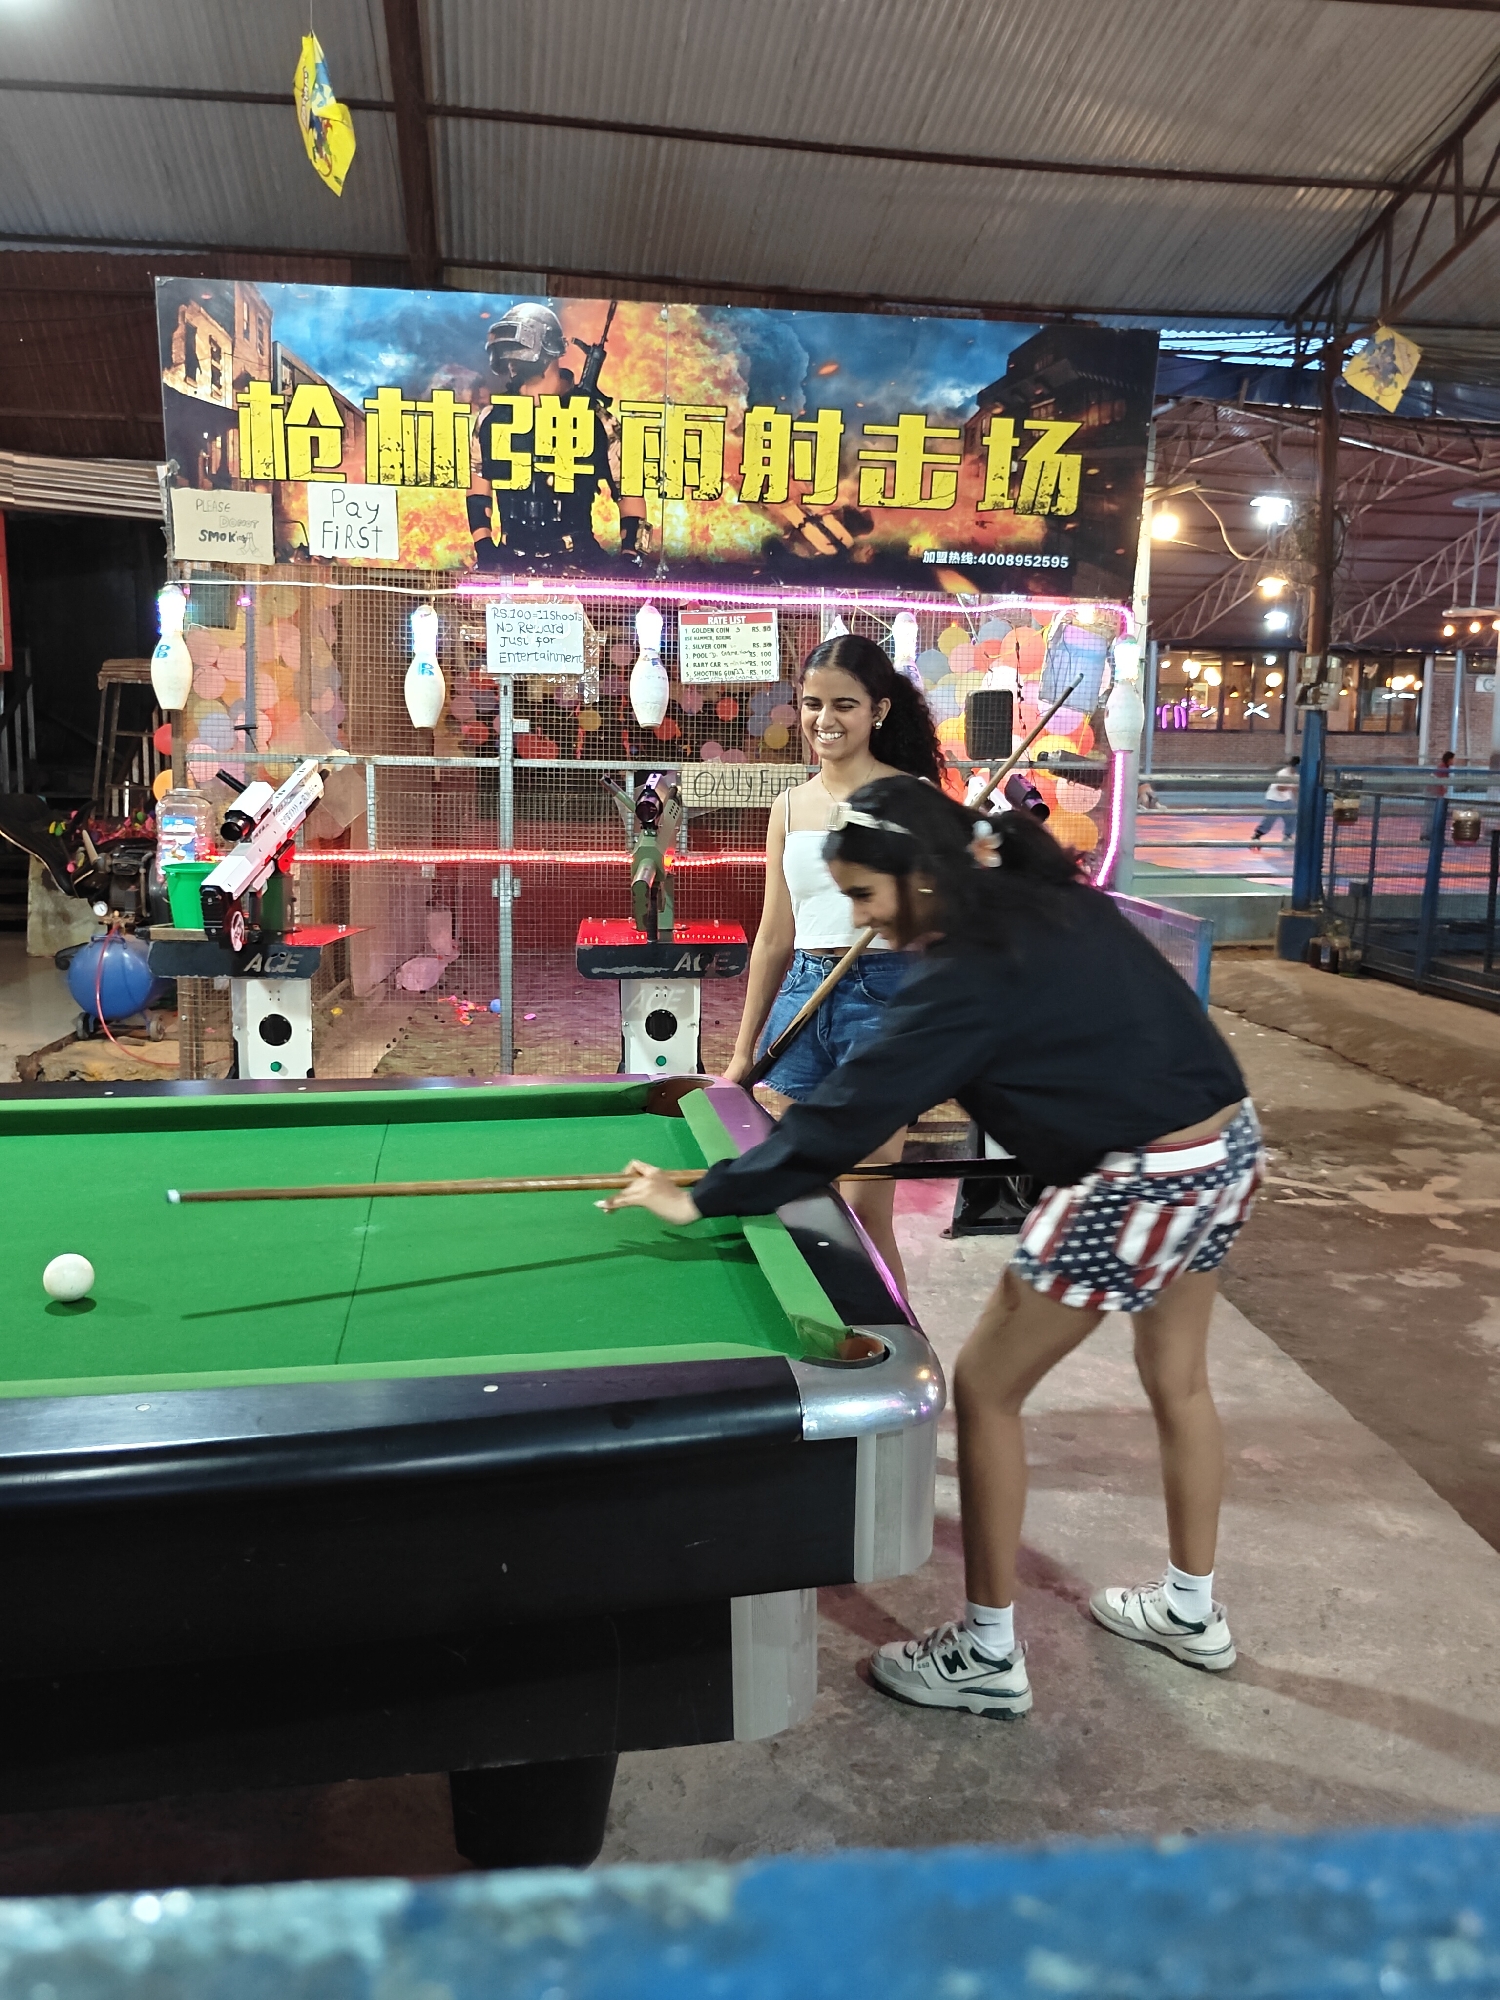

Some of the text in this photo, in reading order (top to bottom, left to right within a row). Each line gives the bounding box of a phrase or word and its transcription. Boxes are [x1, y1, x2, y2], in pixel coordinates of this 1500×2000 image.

[237, 381, 1084, 516] 枪林弹雨射击场
[195, 498, 231, 512] PLEASE
[332, 488, 379, 524] Pay
[707, 616, 746, 625] RATE LIST
[535, 636, 557, 647] for
[499, 650, 584, 663] Entertainment
[243, 951, 304, 973] ACE
